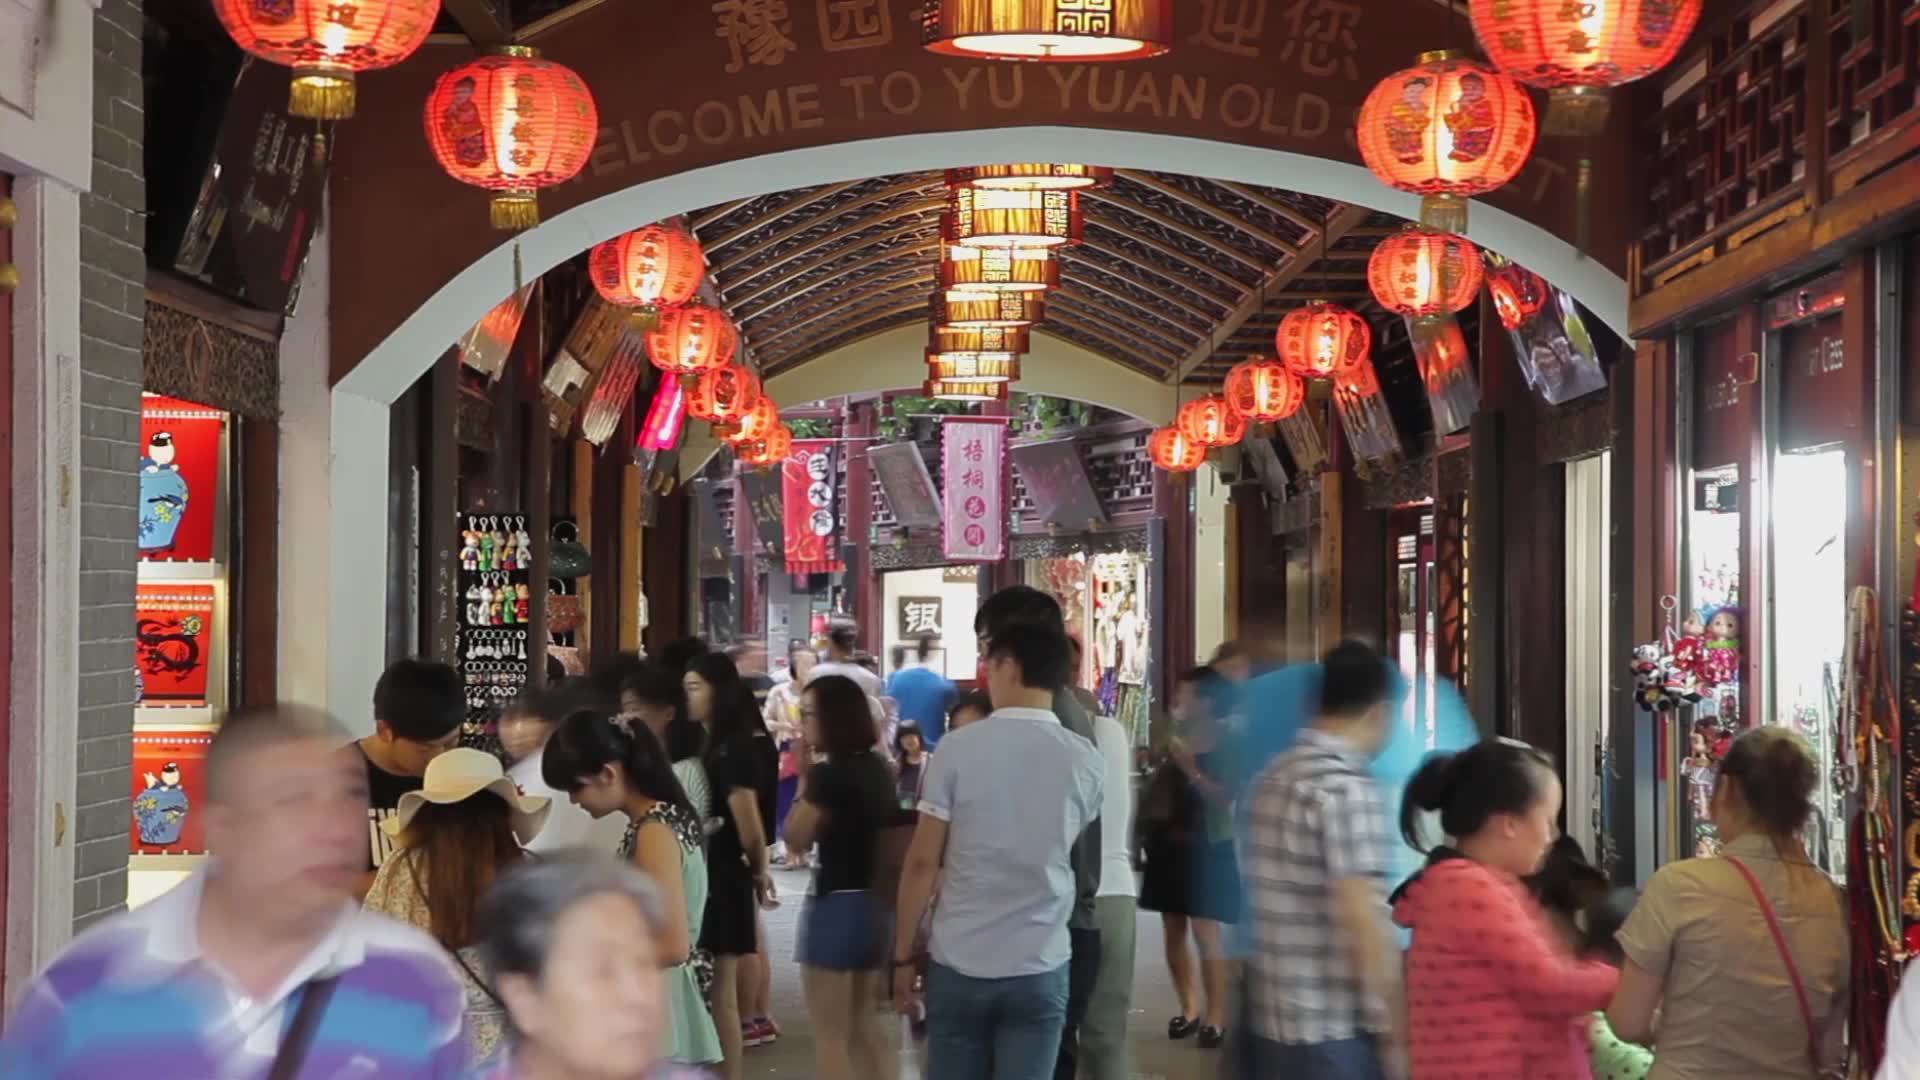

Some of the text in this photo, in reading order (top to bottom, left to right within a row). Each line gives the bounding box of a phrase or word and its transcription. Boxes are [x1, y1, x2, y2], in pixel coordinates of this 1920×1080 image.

[577, 83, 825, 181] ELCOME
[840, 70, 921, 120] TO
[944, 64, 1023, 110] YU
[1045, 64, 1206, 120] YUAN
[1219, 83, 1330, 139] OLD
